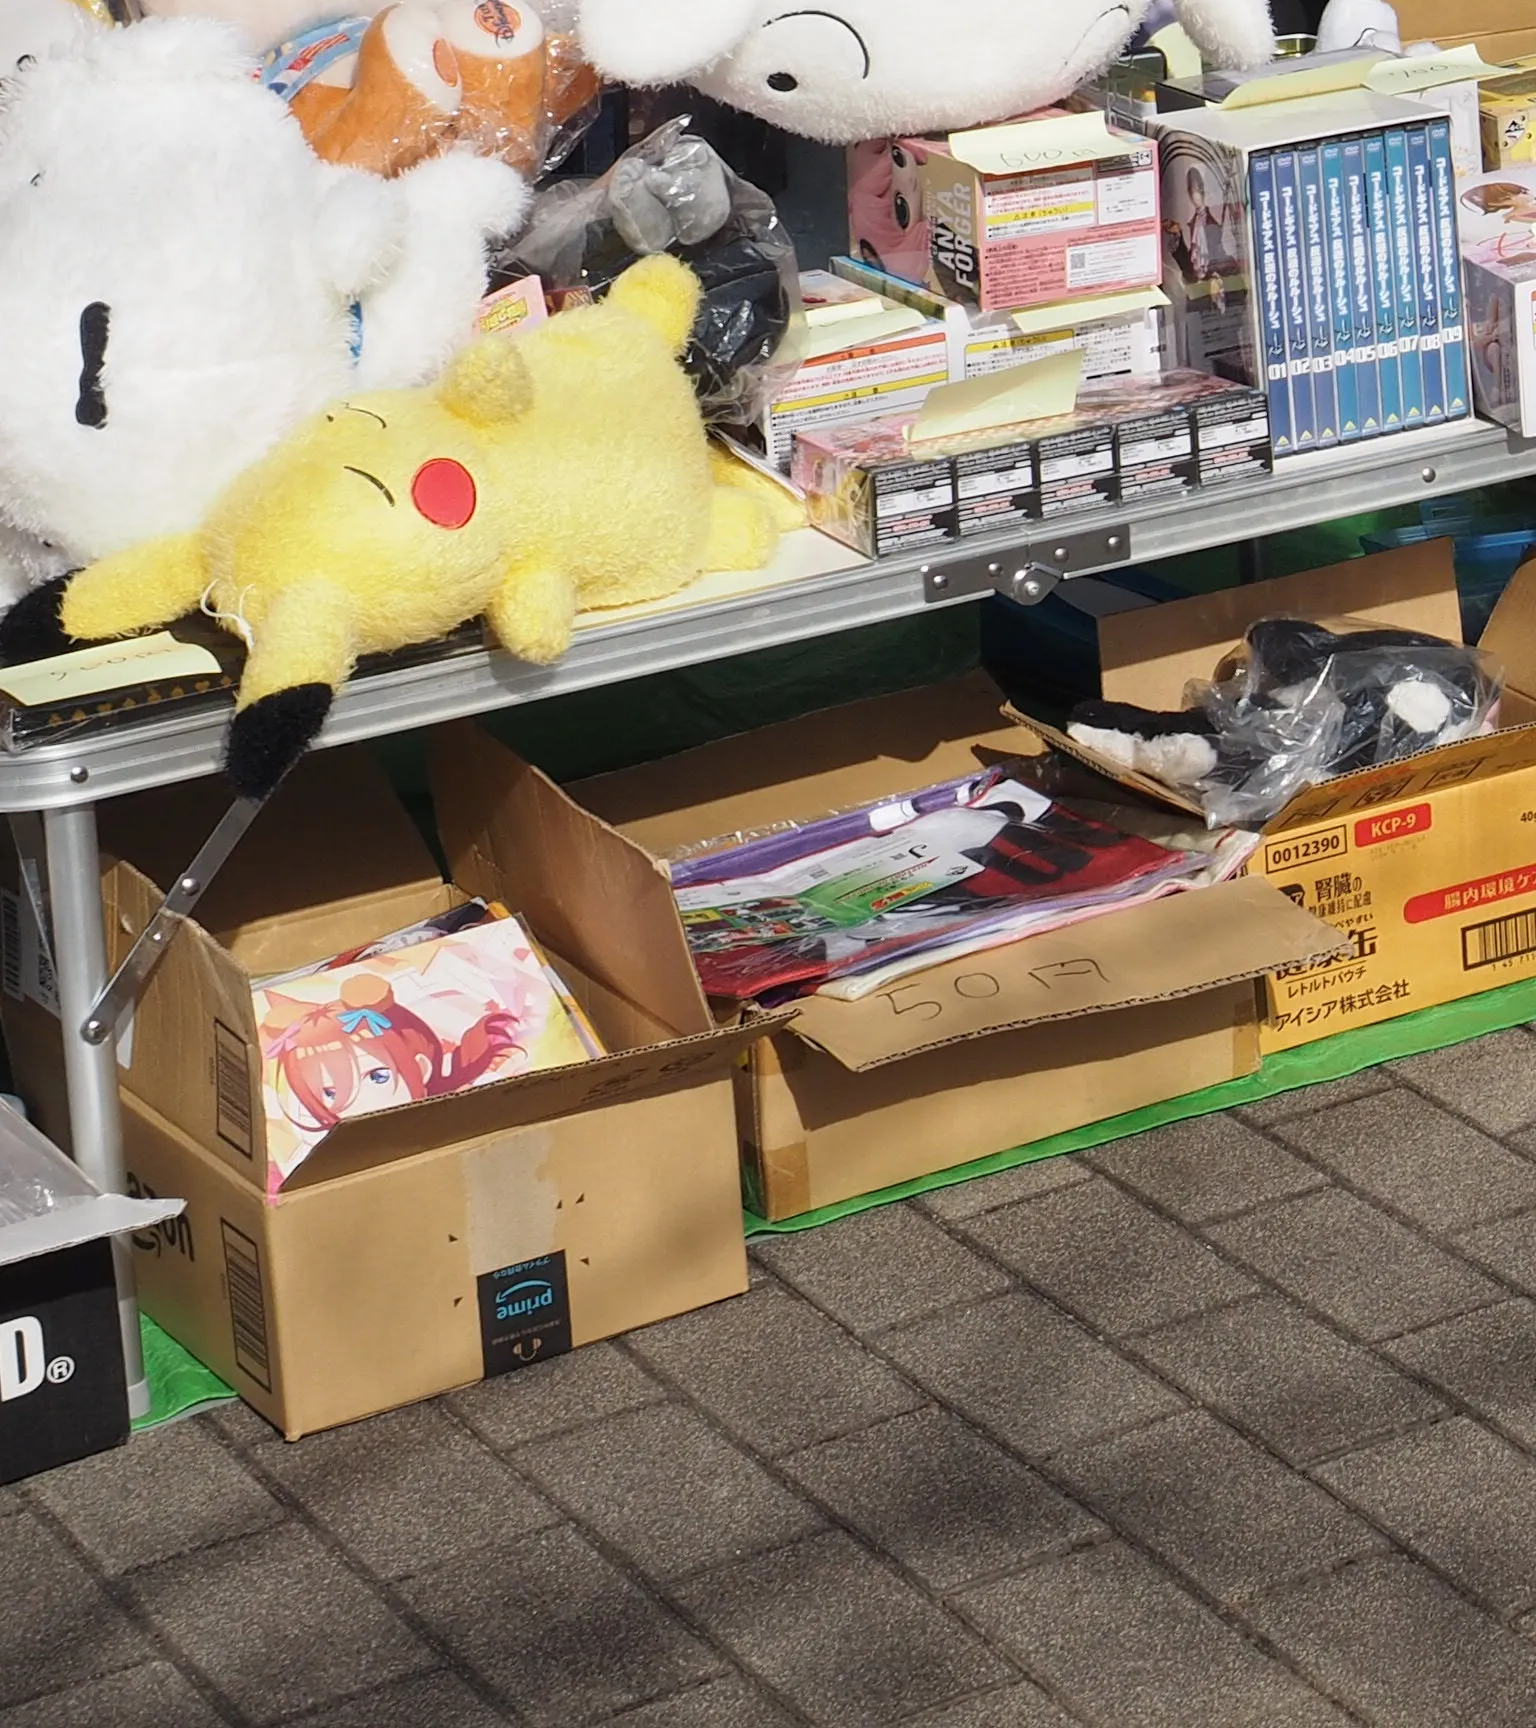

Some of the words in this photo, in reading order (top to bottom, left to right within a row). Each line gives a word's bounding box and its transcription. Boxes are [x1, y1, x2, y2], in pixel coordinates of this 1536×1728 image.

[1282, 186, 1297, 247] コードギアス
[1306, 184, 1321, 245] コードギアス
[1328, 178, 1343, 237] コードギアス
[1348, 176, 1363, 236] コードギアス
[1371, 171, 1385, 232] コードギアス
[1392, 166, 1406, 225] コードギアス
[1414, 165, 1429, 224] コードギアス
[1436, 158, 1450, 216] コードギアス
[932, 189, 957, 272] ANYA
[954, 181, 976, 290] FORGER
[1259, 191, 1275, 251] コードギアス
[1309, 245, 1327, 322] 反逆のルルーシュ
[1331, 238, 1348, 315] 反逆のルルーシュ
[1352, 236, 1369, 312] 反逆のルルーシュ
[1374, 232, 1391, 309] 反逆のルルーシュ
[1396, 226, 1413, 302] 反逆のルルーシュ
[1417, 225, 1434, 301] 反逆のルルーシュ
[1439, 217, 1456, 293] 反逆のルルーシュ
[1263, 252, 1280, 330] 反逆のルルーシュ
[1286, 247, 1303, 325] 反逆のルルーシュ
[1268, 364, 1287, 380] 01
[1290, 359, 1311, 376] 02
[1312, 356, 1333, 373] 03
[1335, 349, 1352, 366] 04
[1355, 346, 1376, 363] 05
[1378, 342, 1398, 360] 06
[1399, 335, 1418, 353] 07
[1421, 334, 1440, 351] 08
[1272, 835, 1340, 865] 0012390
[1371, 812, 1417, 838] KCP-9
[1314, 872, 1363, 903] 腎臓の
[1334, 911, 1374, 929] べやすい
[1275, 979, 1411, 1033] アイシア株式会社
[1288, 966, 1368, 1000] レトルトパウチ
[496, 1288, 552, 1320] prime
